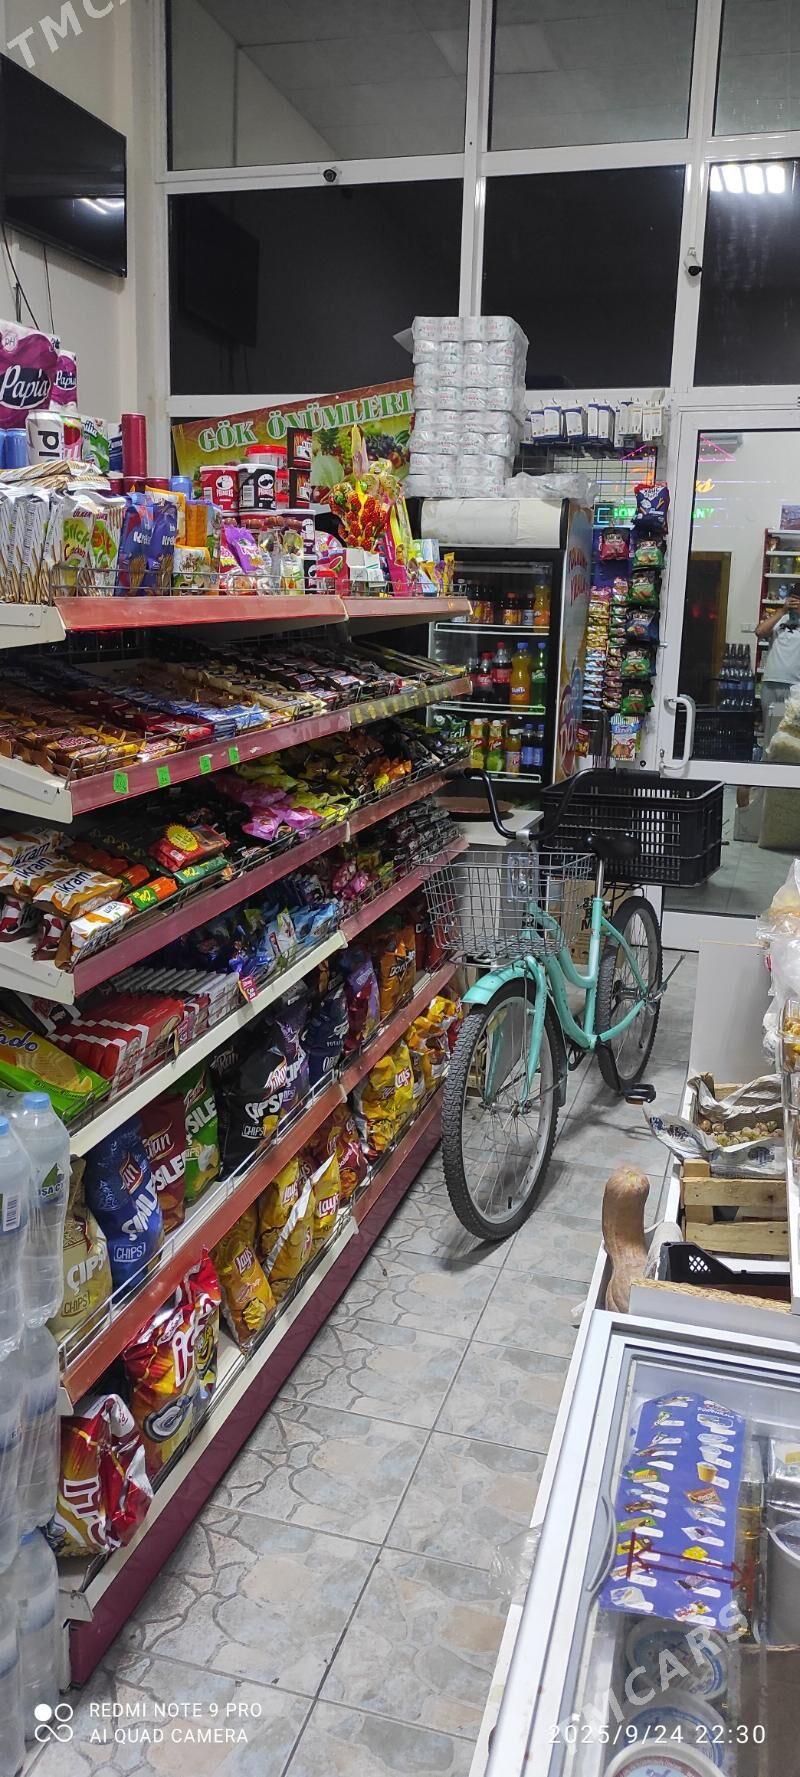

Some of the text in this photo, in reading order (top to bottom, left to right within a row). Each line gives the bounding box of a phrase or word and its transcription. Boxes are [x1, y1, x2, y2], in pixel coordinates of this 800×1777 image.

[0, 364, 49, 408] Papia
[53, 370, 77, 388] Papia
[198, 420, 258, 452] GÖK
[116, 1245, 143, 1260] CHIPS
[64, 1294, 88, 1315] CHIPS
